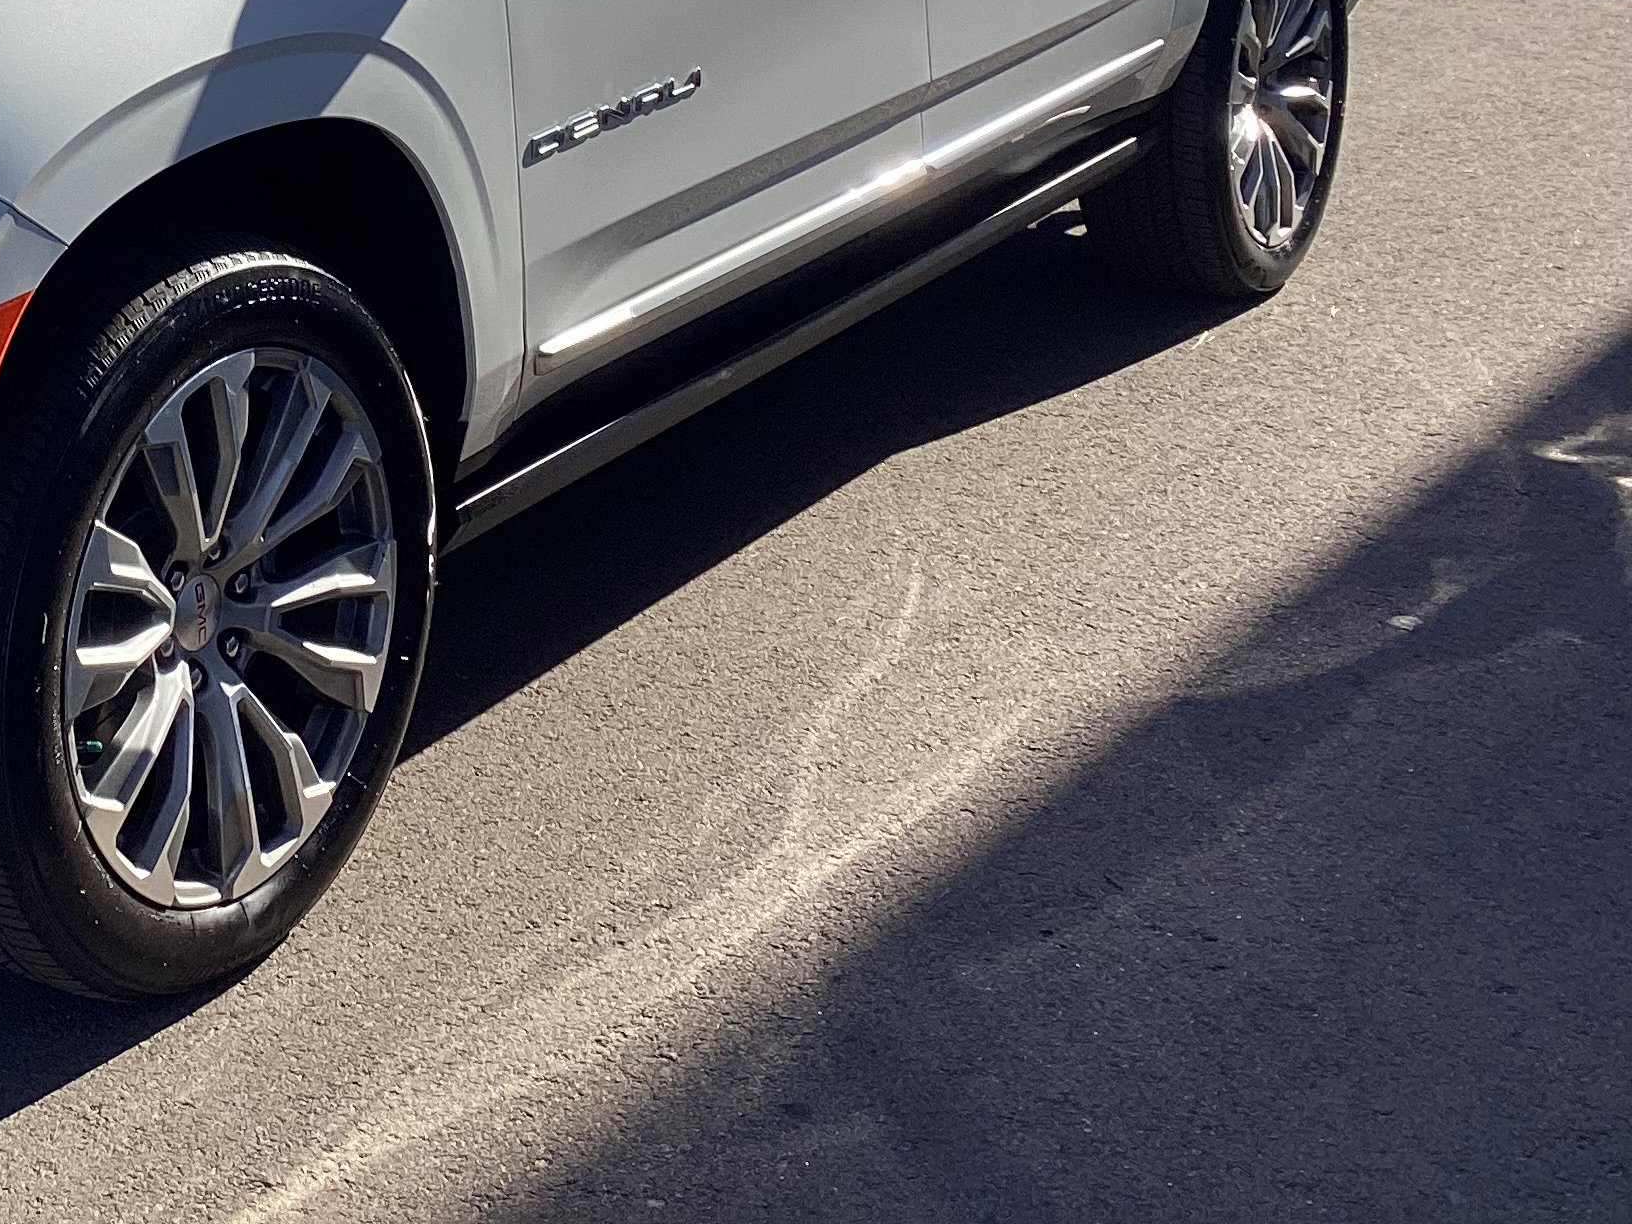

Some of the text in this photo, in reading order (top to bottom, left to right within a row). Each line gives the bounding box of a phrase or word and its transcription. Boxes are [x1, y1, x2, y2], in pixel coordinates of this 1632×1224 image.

[523, 65, 702, 169] DENALI
[196, 278, 321, 328] DGESTONE
[195, 581, 207, 645] GMC
